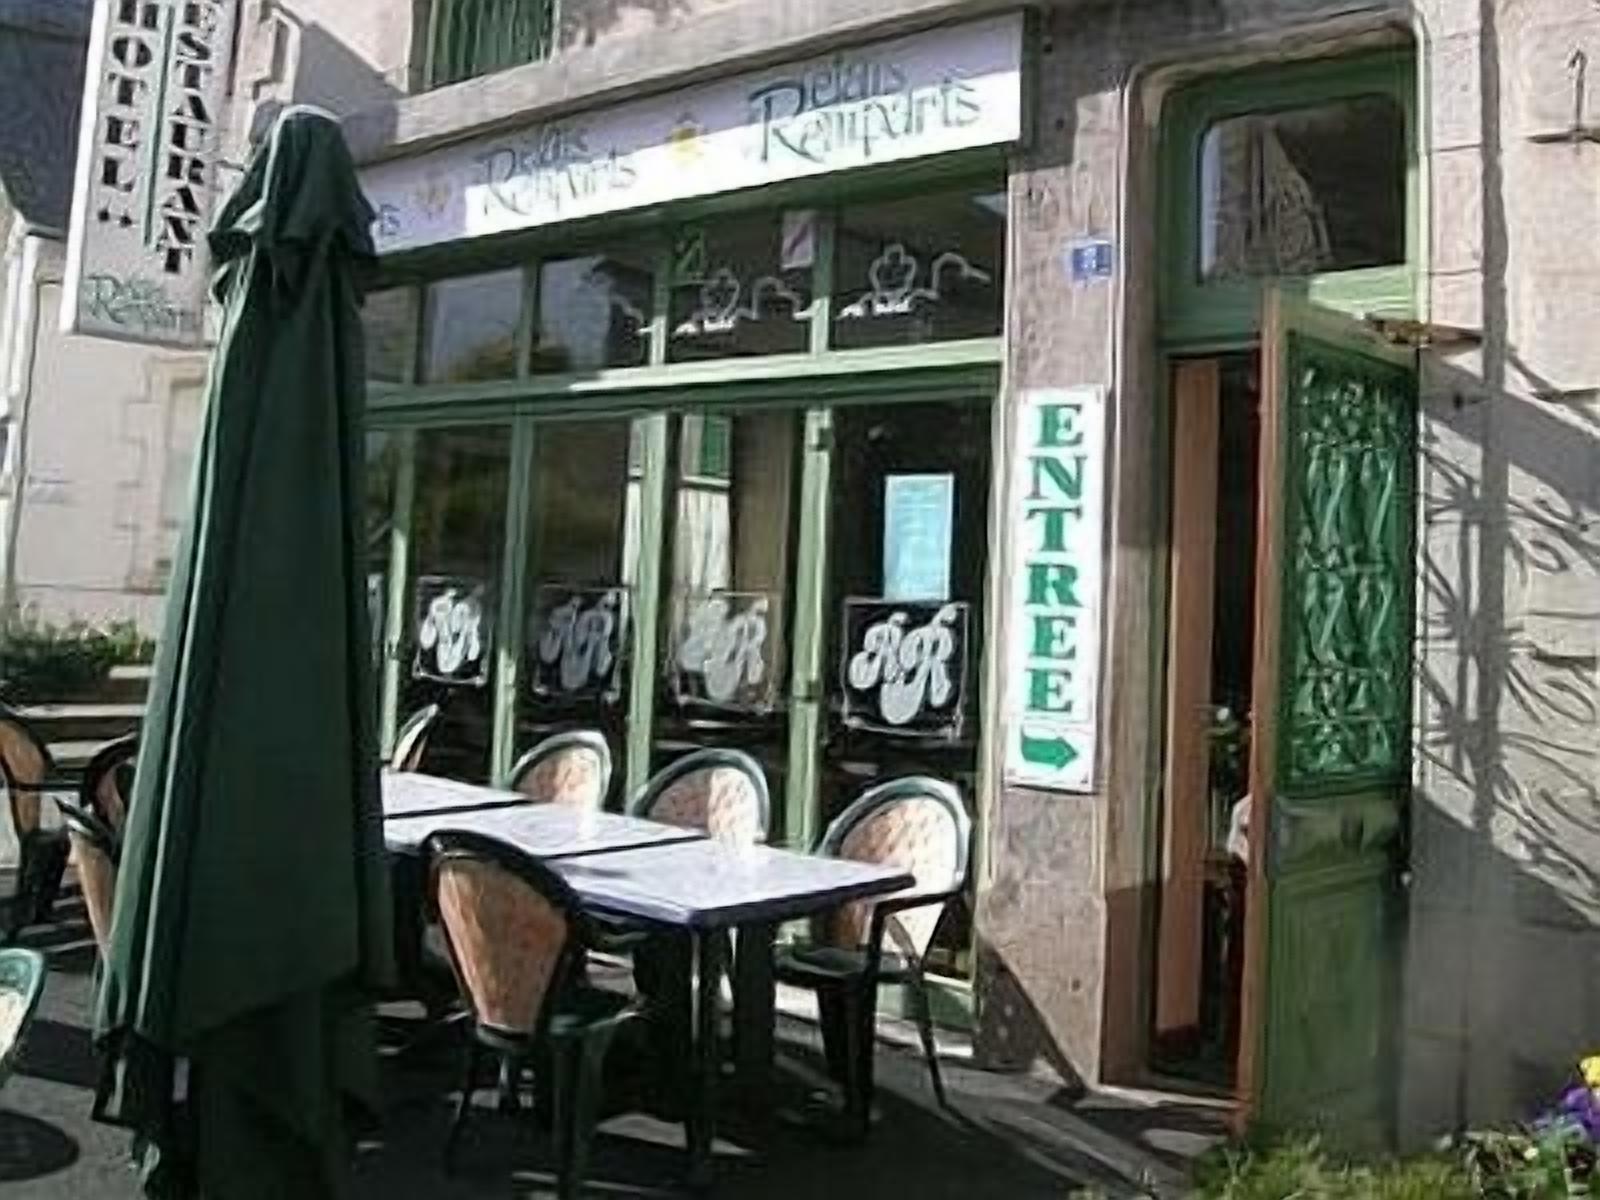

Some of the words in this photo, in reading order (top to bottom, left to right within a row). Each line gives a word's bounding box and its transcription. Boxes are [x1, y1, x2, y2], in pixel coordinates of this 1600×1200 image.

[102, 0, 158, 192] HOTEL
[156, 0, 218, 274] ESTAURANT
[1024, 402, 1087, 714] ENTREE
